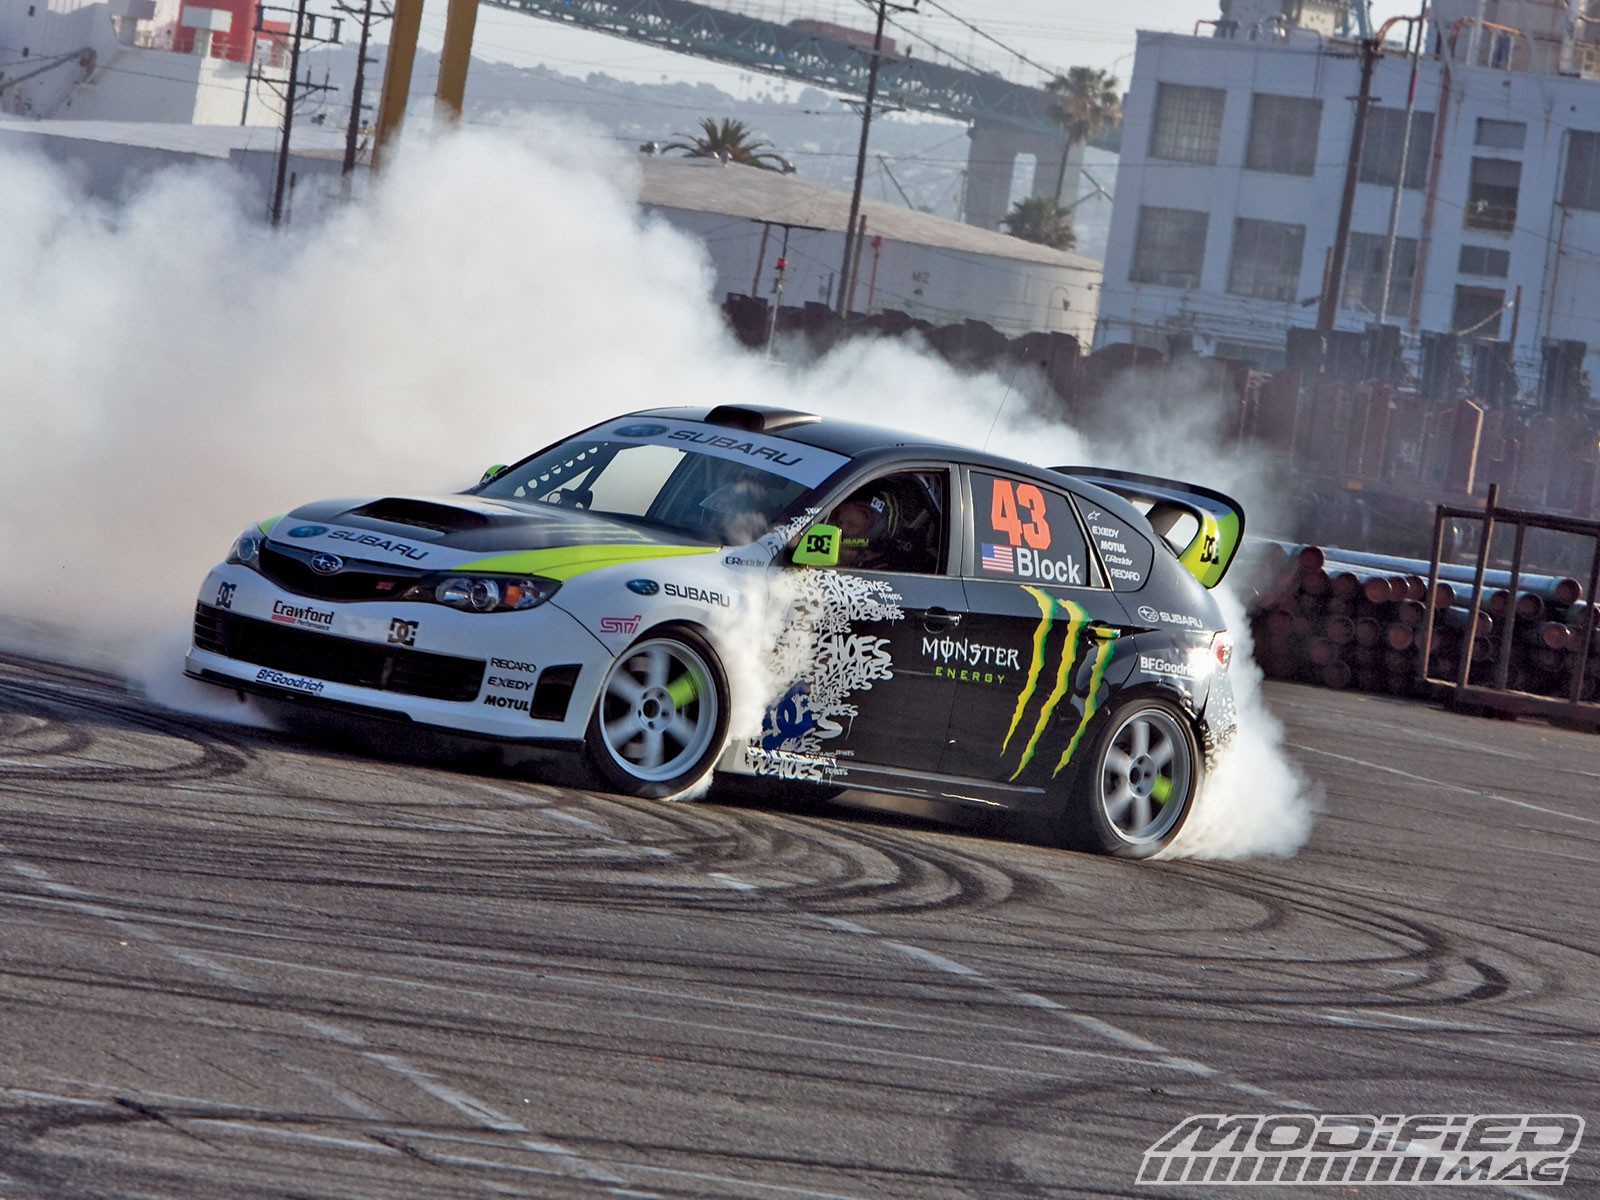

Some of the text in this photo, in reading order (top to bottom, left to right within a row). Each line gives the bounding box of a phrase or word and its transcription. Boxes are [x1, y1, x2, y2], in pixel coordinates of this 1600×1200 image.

[668, 430, 803, 466] SUBARU
[991, 479, 1051, 550] 43
[1092, 525, 1119, 538] EXEDY
[327, 530, 429, 560] SUBARU
[1100, 540, 1127, 554] MOTUL
[1016, 546, 1081, 585] Block
[1110, 568, 1140, 582] RECARO
[664, 583, 730, 608] SUBARU
[273, 600, 335, 625] Crawford
[1159, 611, 1203, 628] SUBARU
[921, 636, 1021, 671] MONSTER
[490, 657, 537, 674] RECARO
[935, 666, 1005, 683] ENERGY
[256, 669, 325, 693] BFGoodrich
[487, 676, 534, 692] EXEDY
[483, 694, 529, 712] MOTUL
